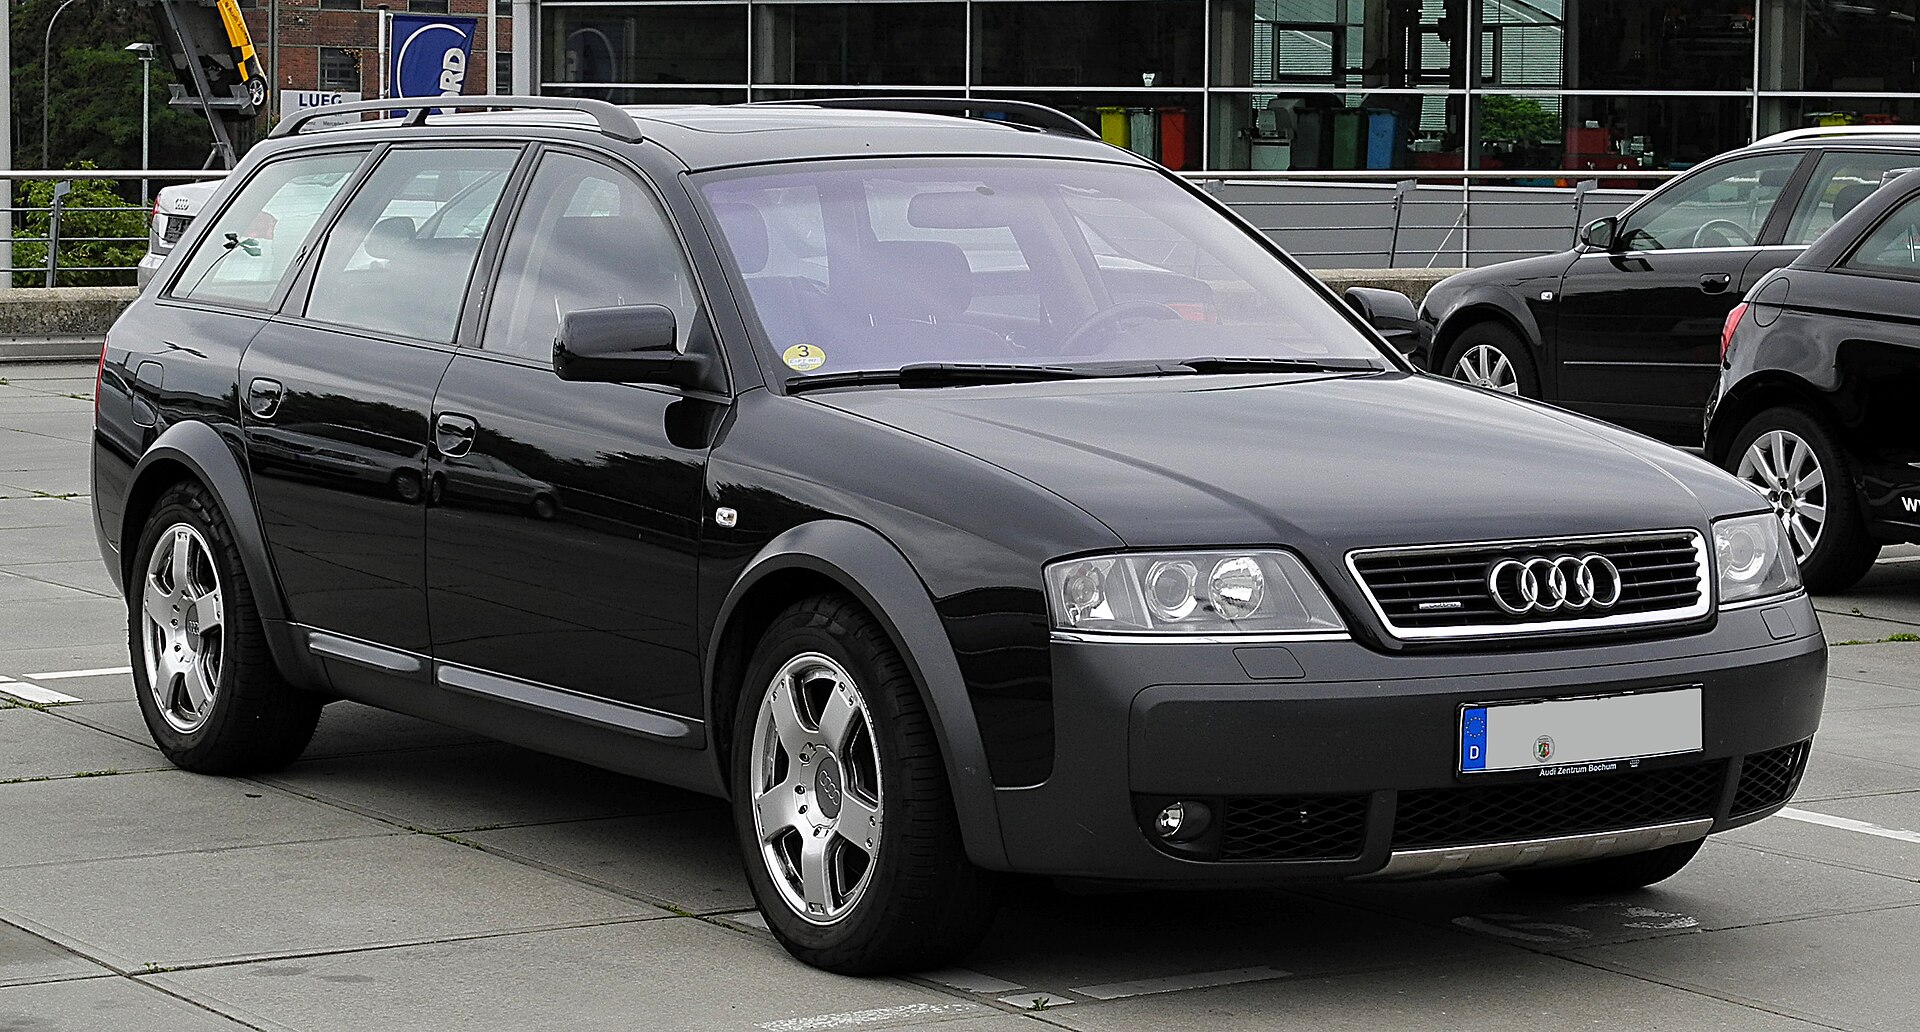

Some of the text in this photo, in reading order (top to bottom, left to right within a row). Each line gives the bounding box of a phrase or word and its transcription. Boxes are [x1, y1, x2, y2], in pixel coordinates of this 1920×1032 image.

[439, 47, 466, 97] RD
[797, 345, 809, 357] 3
[1469, 745, 1479, 759] D
[1539, 763, 1617, 776] Audi Zentrum Bochum
